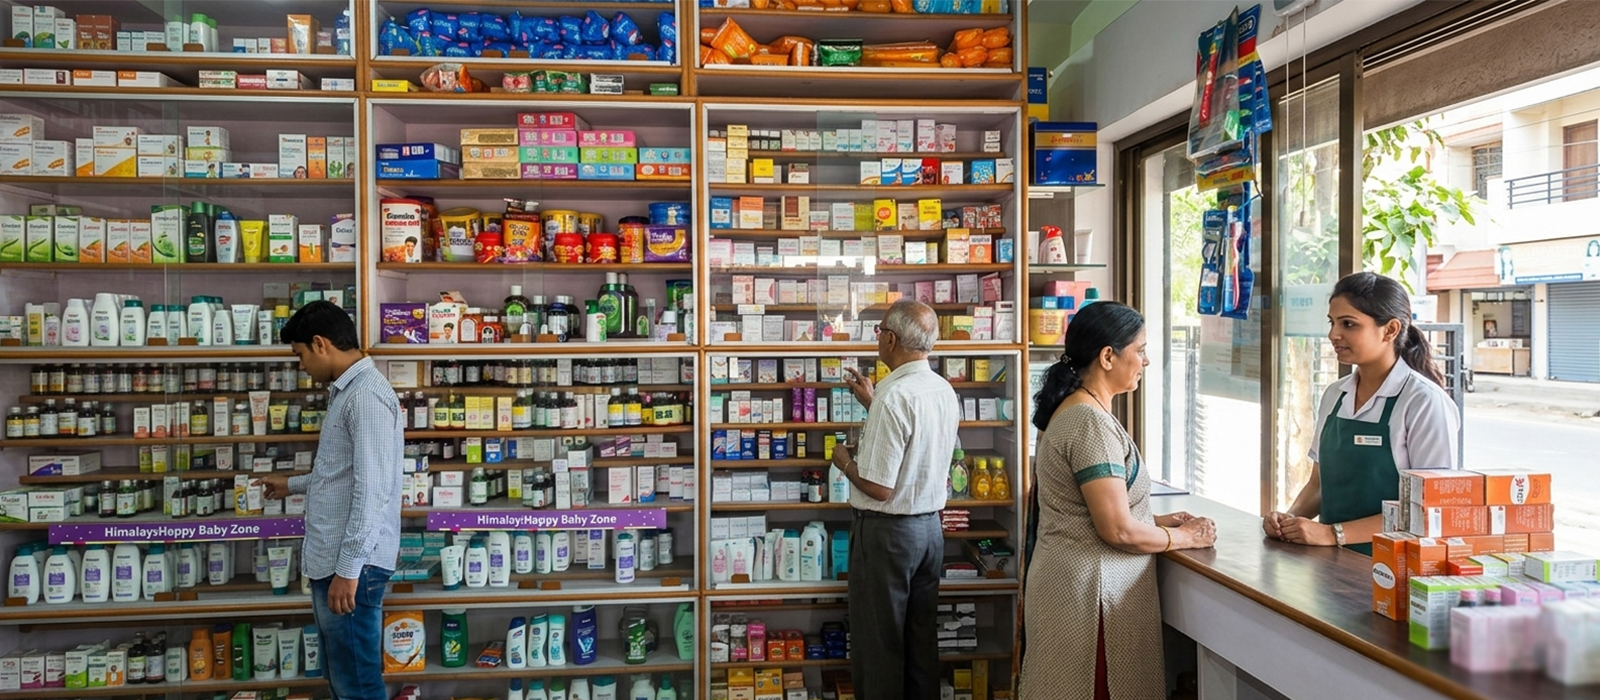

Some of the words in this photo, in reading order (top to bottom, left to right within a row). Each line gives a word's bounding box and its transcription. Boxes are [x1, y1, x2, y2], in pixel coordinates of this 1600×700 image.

[589, 514, 617, 524] Zone
[199, 524, 228, 537] Baby
[230, 523, 260, 534] Zone
